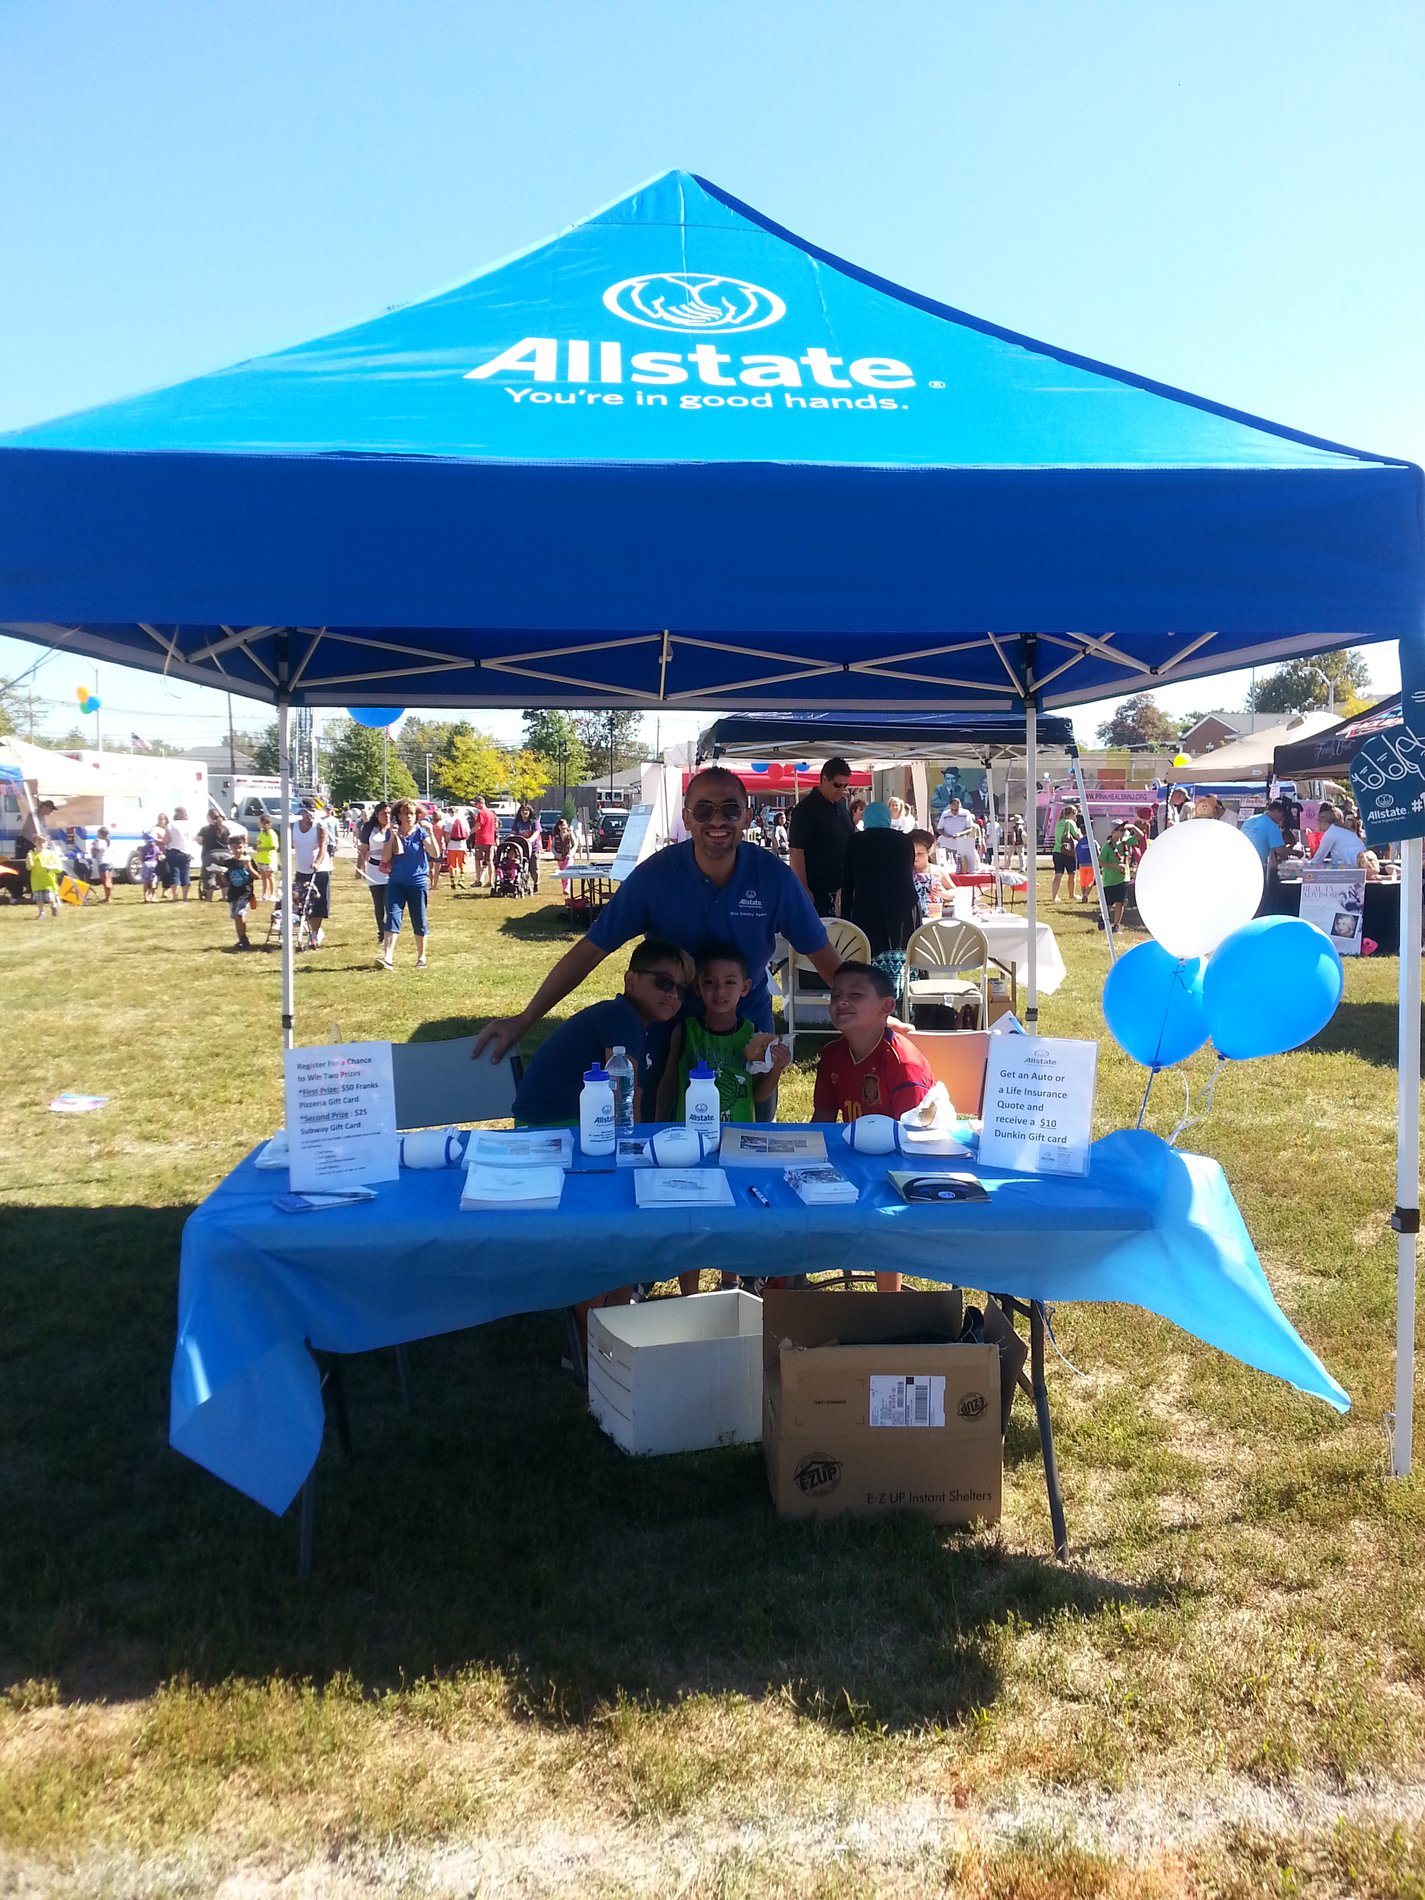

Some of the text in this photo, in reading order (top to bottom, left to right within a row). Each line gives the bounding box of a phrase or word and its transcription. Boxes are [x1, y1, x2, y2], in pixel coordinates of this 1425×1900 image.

[462, 336, 916, 388] Allstate
[504, 387, 908, 410] You're in good hands.
[1367, 806, 1408, 822] Allstate
[297, 1062, 326, 1072] Register
[347, 1057, 372, 1065] Chance
[1024, 1057, 1057, 1065] Allstate
[308, 1073, 322, 1082] Win
[340, 1070, 361, 1078] Prizes
[1000, 1070, 1016, 1079] Get
[1031, 1072, 1052, 1082] Auto
[356, 1081, 378, 1090] Franks
[1006, 1086, 1022, 1095] Life
[1024, 1088, 1068, 1099] Insurance
[299, 1095, 359, 1109] Pizzeria Gift Card
[997, 1100, 1044, 1112] Quote and
[332, 1111, 348, 1120] Prize
[354, 1108, 368, 1117] $25
[996, 1116, 1028, 1125] receive
[1040, 1118, 1057, 1128] $10
[300, 1126, 328, 1135] Subway
[330, 1123, 343, 1132] Gift
[995, 1129, 1067, 1144] Dunkin Gift card
[890, 1492, 906, 1503] UP
[909, 1492, 946, 1503] Instant
[950, 1489, 993, 1502] Shelters
